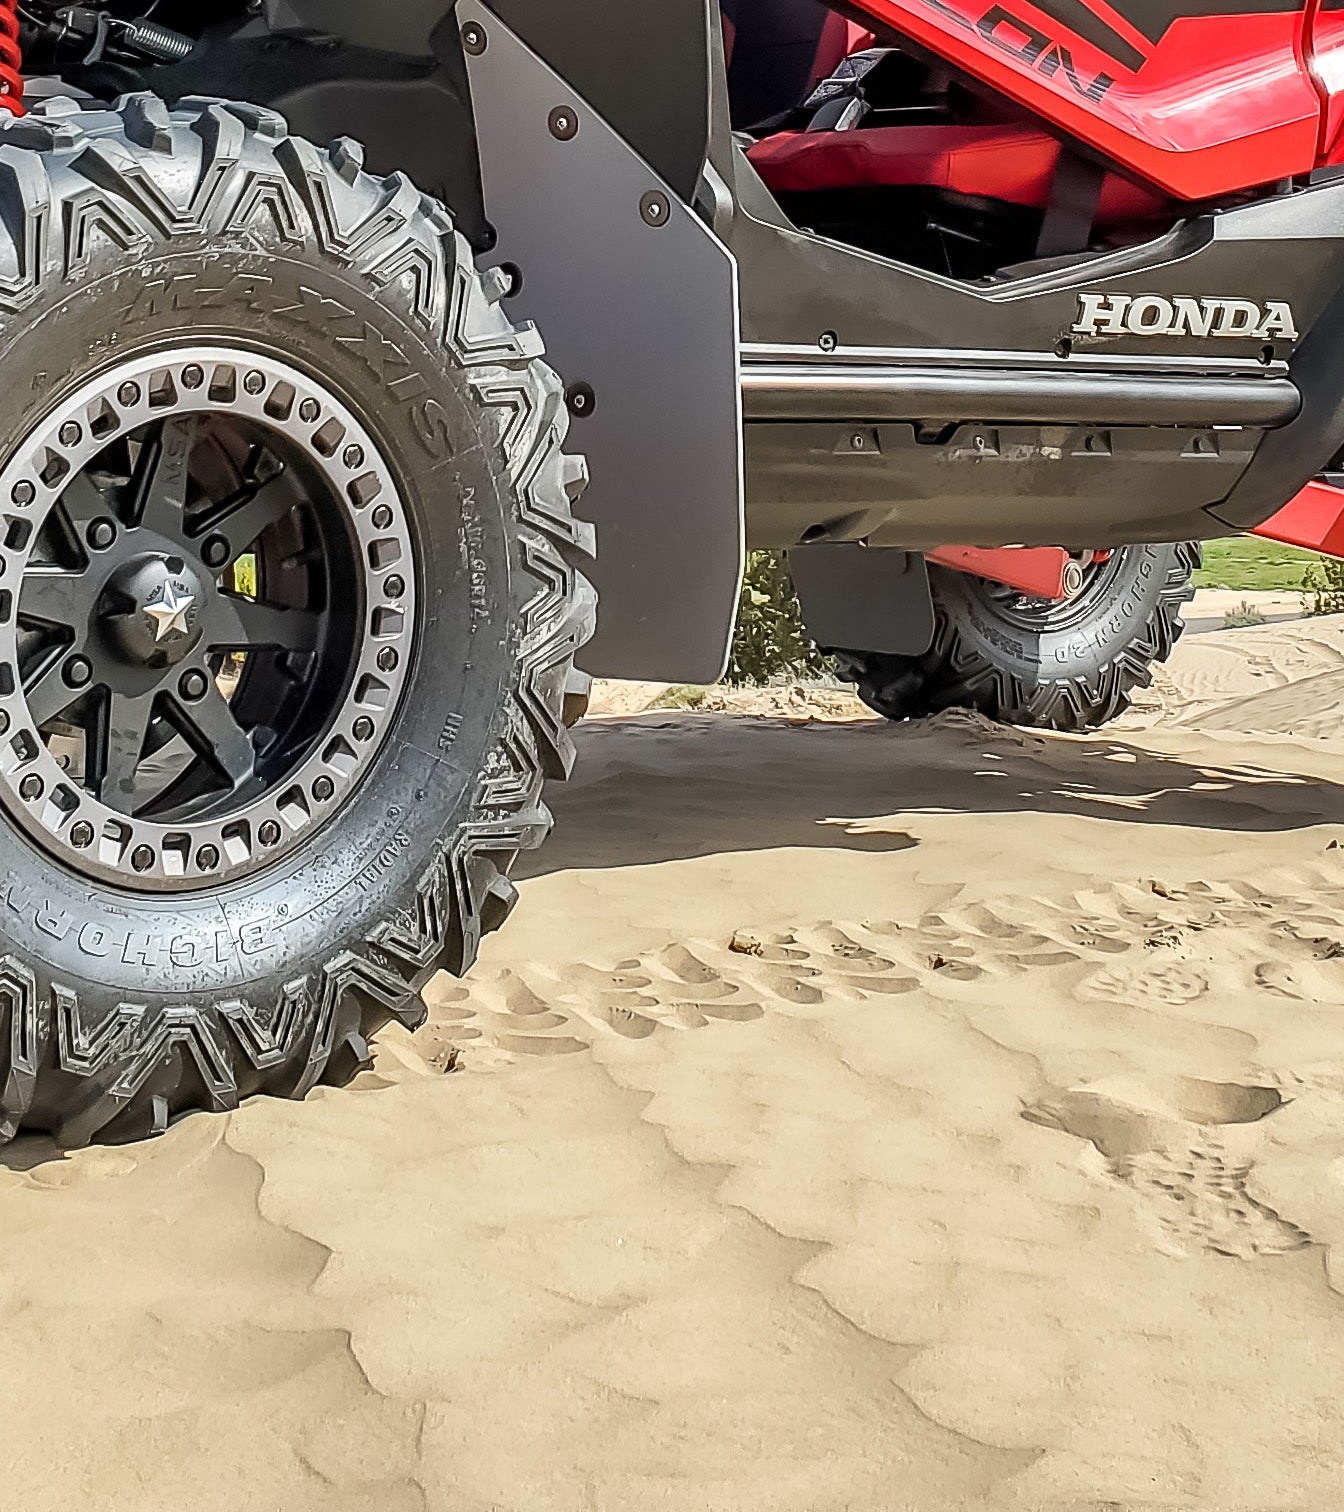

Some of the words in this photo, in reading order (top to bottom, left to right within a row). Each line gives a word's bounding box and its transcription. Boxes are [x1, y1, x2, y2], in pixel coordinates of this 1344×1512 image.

[1070, 291, 1300, 342] HONDA
[119, 272, 455, 459] MAXXIS
[1095, 543, 1157, 648] IGHORN
[354, 831, 411, 892] RADIAL
